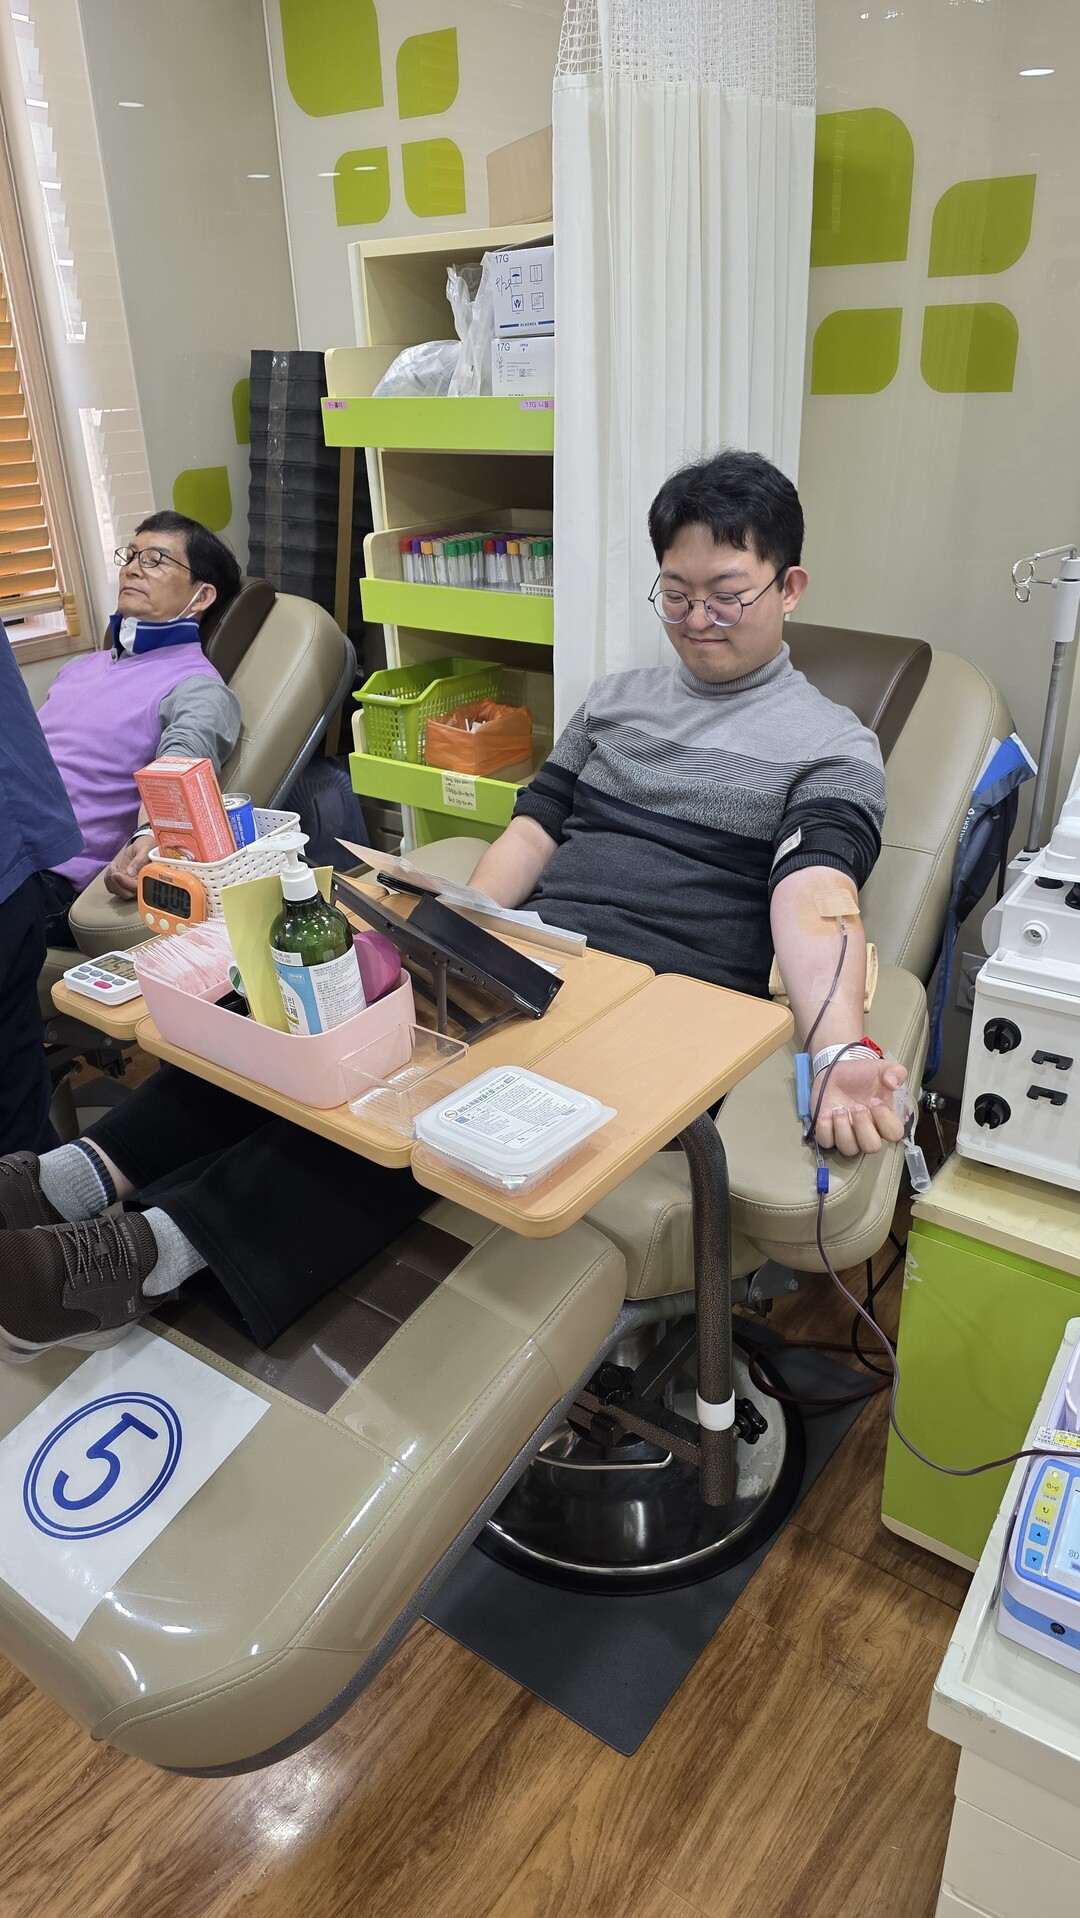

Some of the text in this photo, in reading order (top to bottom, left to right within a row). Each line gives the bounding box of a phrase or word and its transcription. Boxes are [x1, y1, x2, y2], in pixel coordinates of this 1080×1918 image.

[494, 254, 509, 264] 17G
[497, 342, 511, 351] 17G
[53, 1412, 158, 1510] 5
